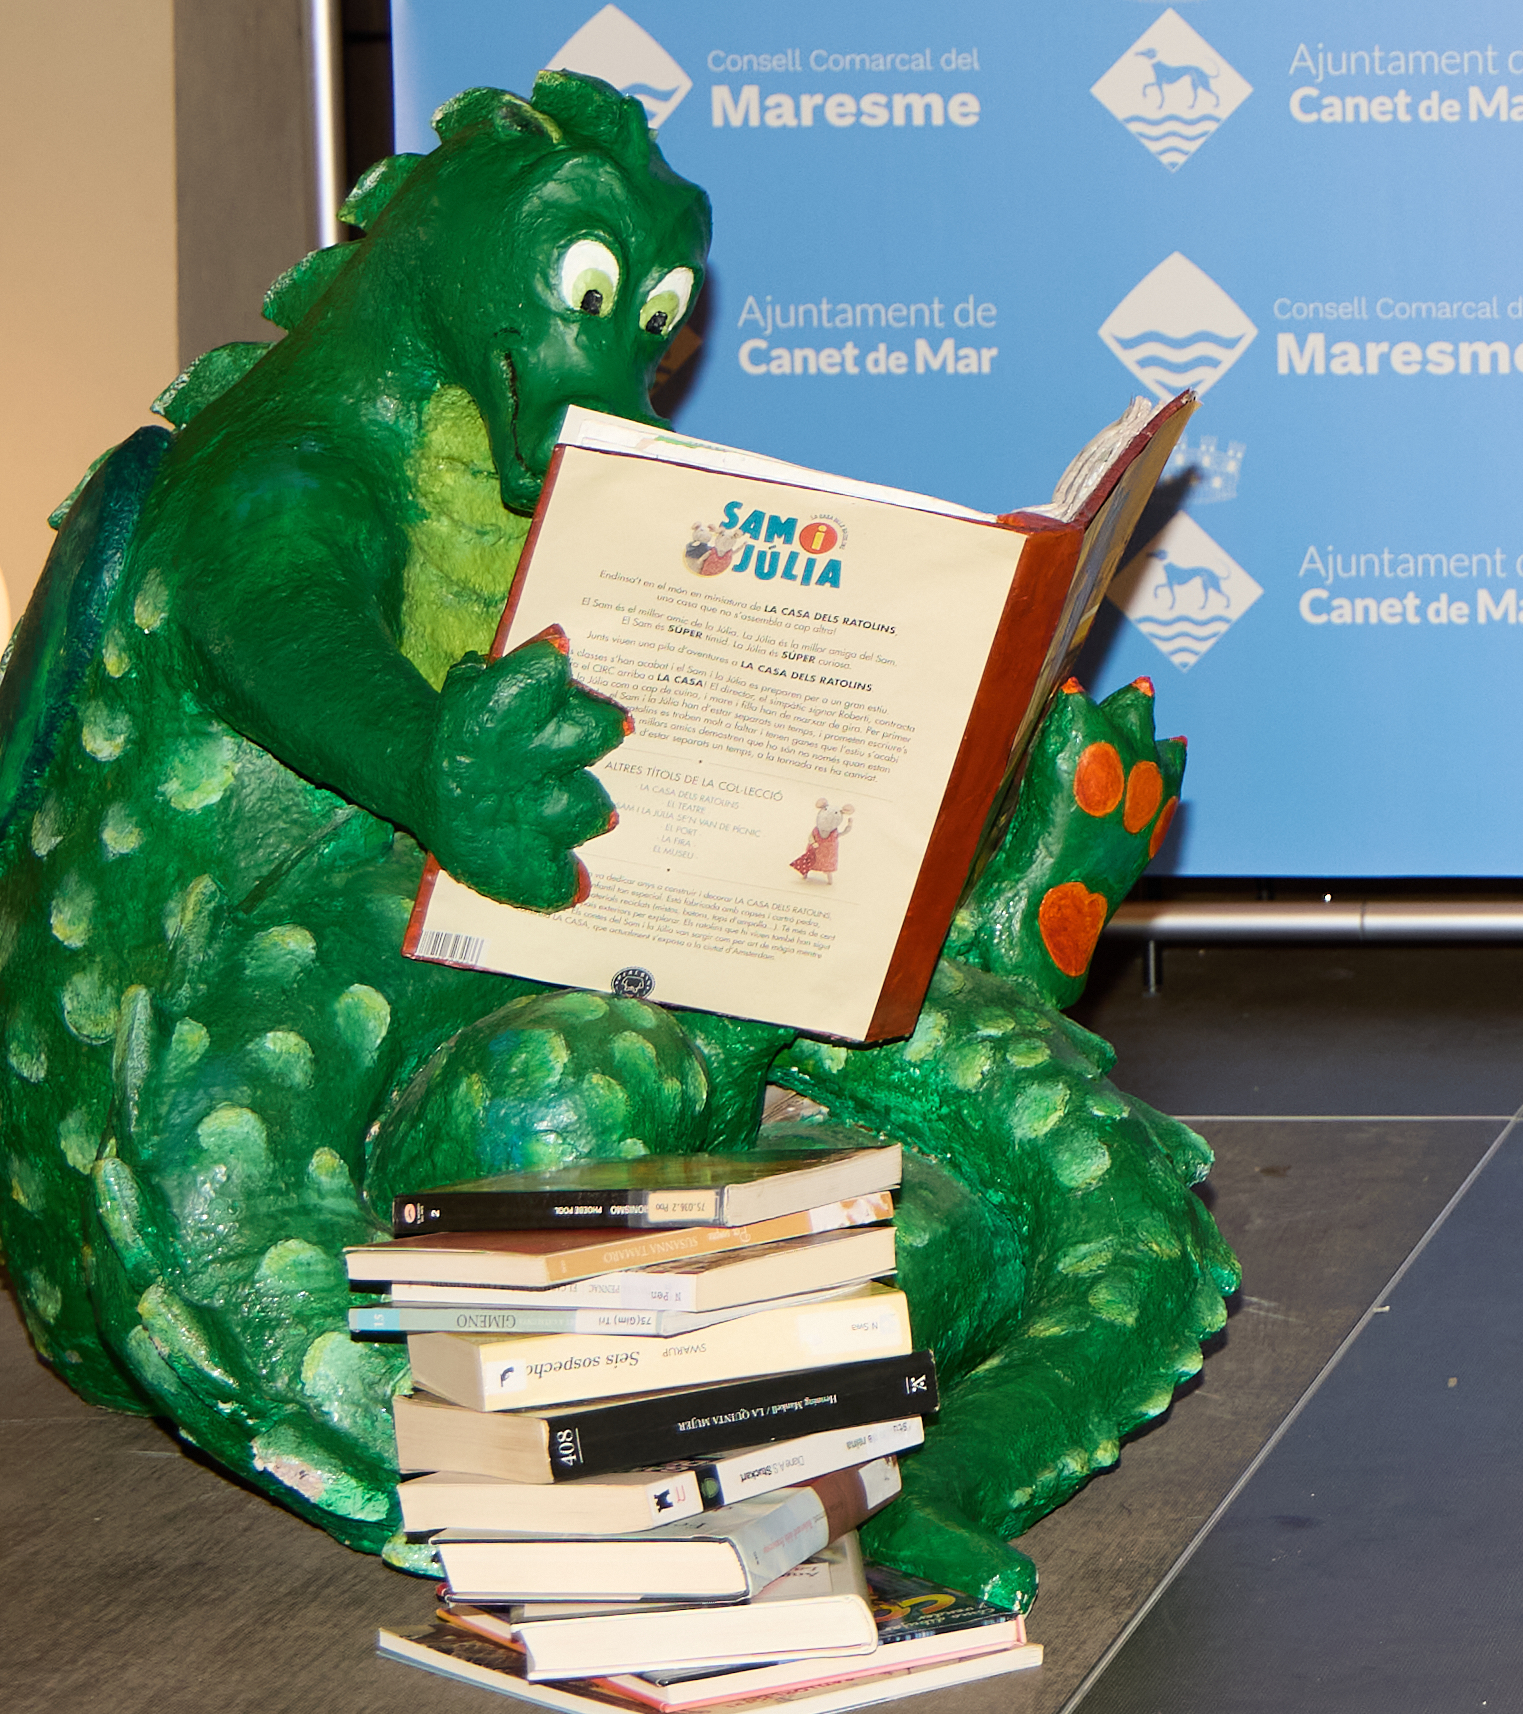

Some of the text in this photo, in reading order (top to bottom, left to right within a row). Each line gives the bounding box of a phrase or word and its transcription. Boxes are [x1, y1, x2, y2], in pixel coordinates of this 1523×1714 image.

[1289, 43, 1497, 82] Ajuntament
[711, 84, 981, 128] Maresme
[1289, 86, 1412, 123] Canet
[1418, 90, 1461, 122] de
[738, 295, 997, 335] Ajuntament de
[738, 338, 999, 375] Canet de Mar
[719, 500, 798, 545] SAM
[731, 543, 842, 589] JÚLIA
[1299, 545, 1505, 585] Ajuntament
[657, 581, 665, 590] el
[668, 584, 688, 595] món
[690, 590, 701, 598] en
[704, 592, 747, 608] miniatura
[749, 601, 762, 611] de
[764, 604, 777, 613] LA
[780, 606, 810, 619] CASA
[813, 612, 839, 623] DELS
[1299, 588, 1421, 625] Canet
[1427, 593, 1470, 625] de
[586, 630, 609, 642] Junts
[612, 634, 636, 646] viuen
[638, 640, 655, 649] una
[657, 641, 675, 654] pila
[740, 660, 754, 669] LA
[757, 664, 787, 677] CASA
[790, 670, 816, 682] DELS
[604, 759, 643, 775] ALTRES
[646, 765, 681, 782] TÍTOLS
[683, 774, 698, 785] DE
[701, 778, 714, 788] LA
[603, 1237, 698, 1264] SUSANNA TAMARO
[588, 1284, 620, 1294] PENNAC
[456, 1314, 516, 1328] GIMENO
[606, 1351, 640, 1366] Seis
[662, 1343, 707, 1357] SWARUP
[677, 1416, 711, 1432] MUJER
[713, 1408, 750, 1425] QUINTA
[557, 1428, 577, 1467] 408
